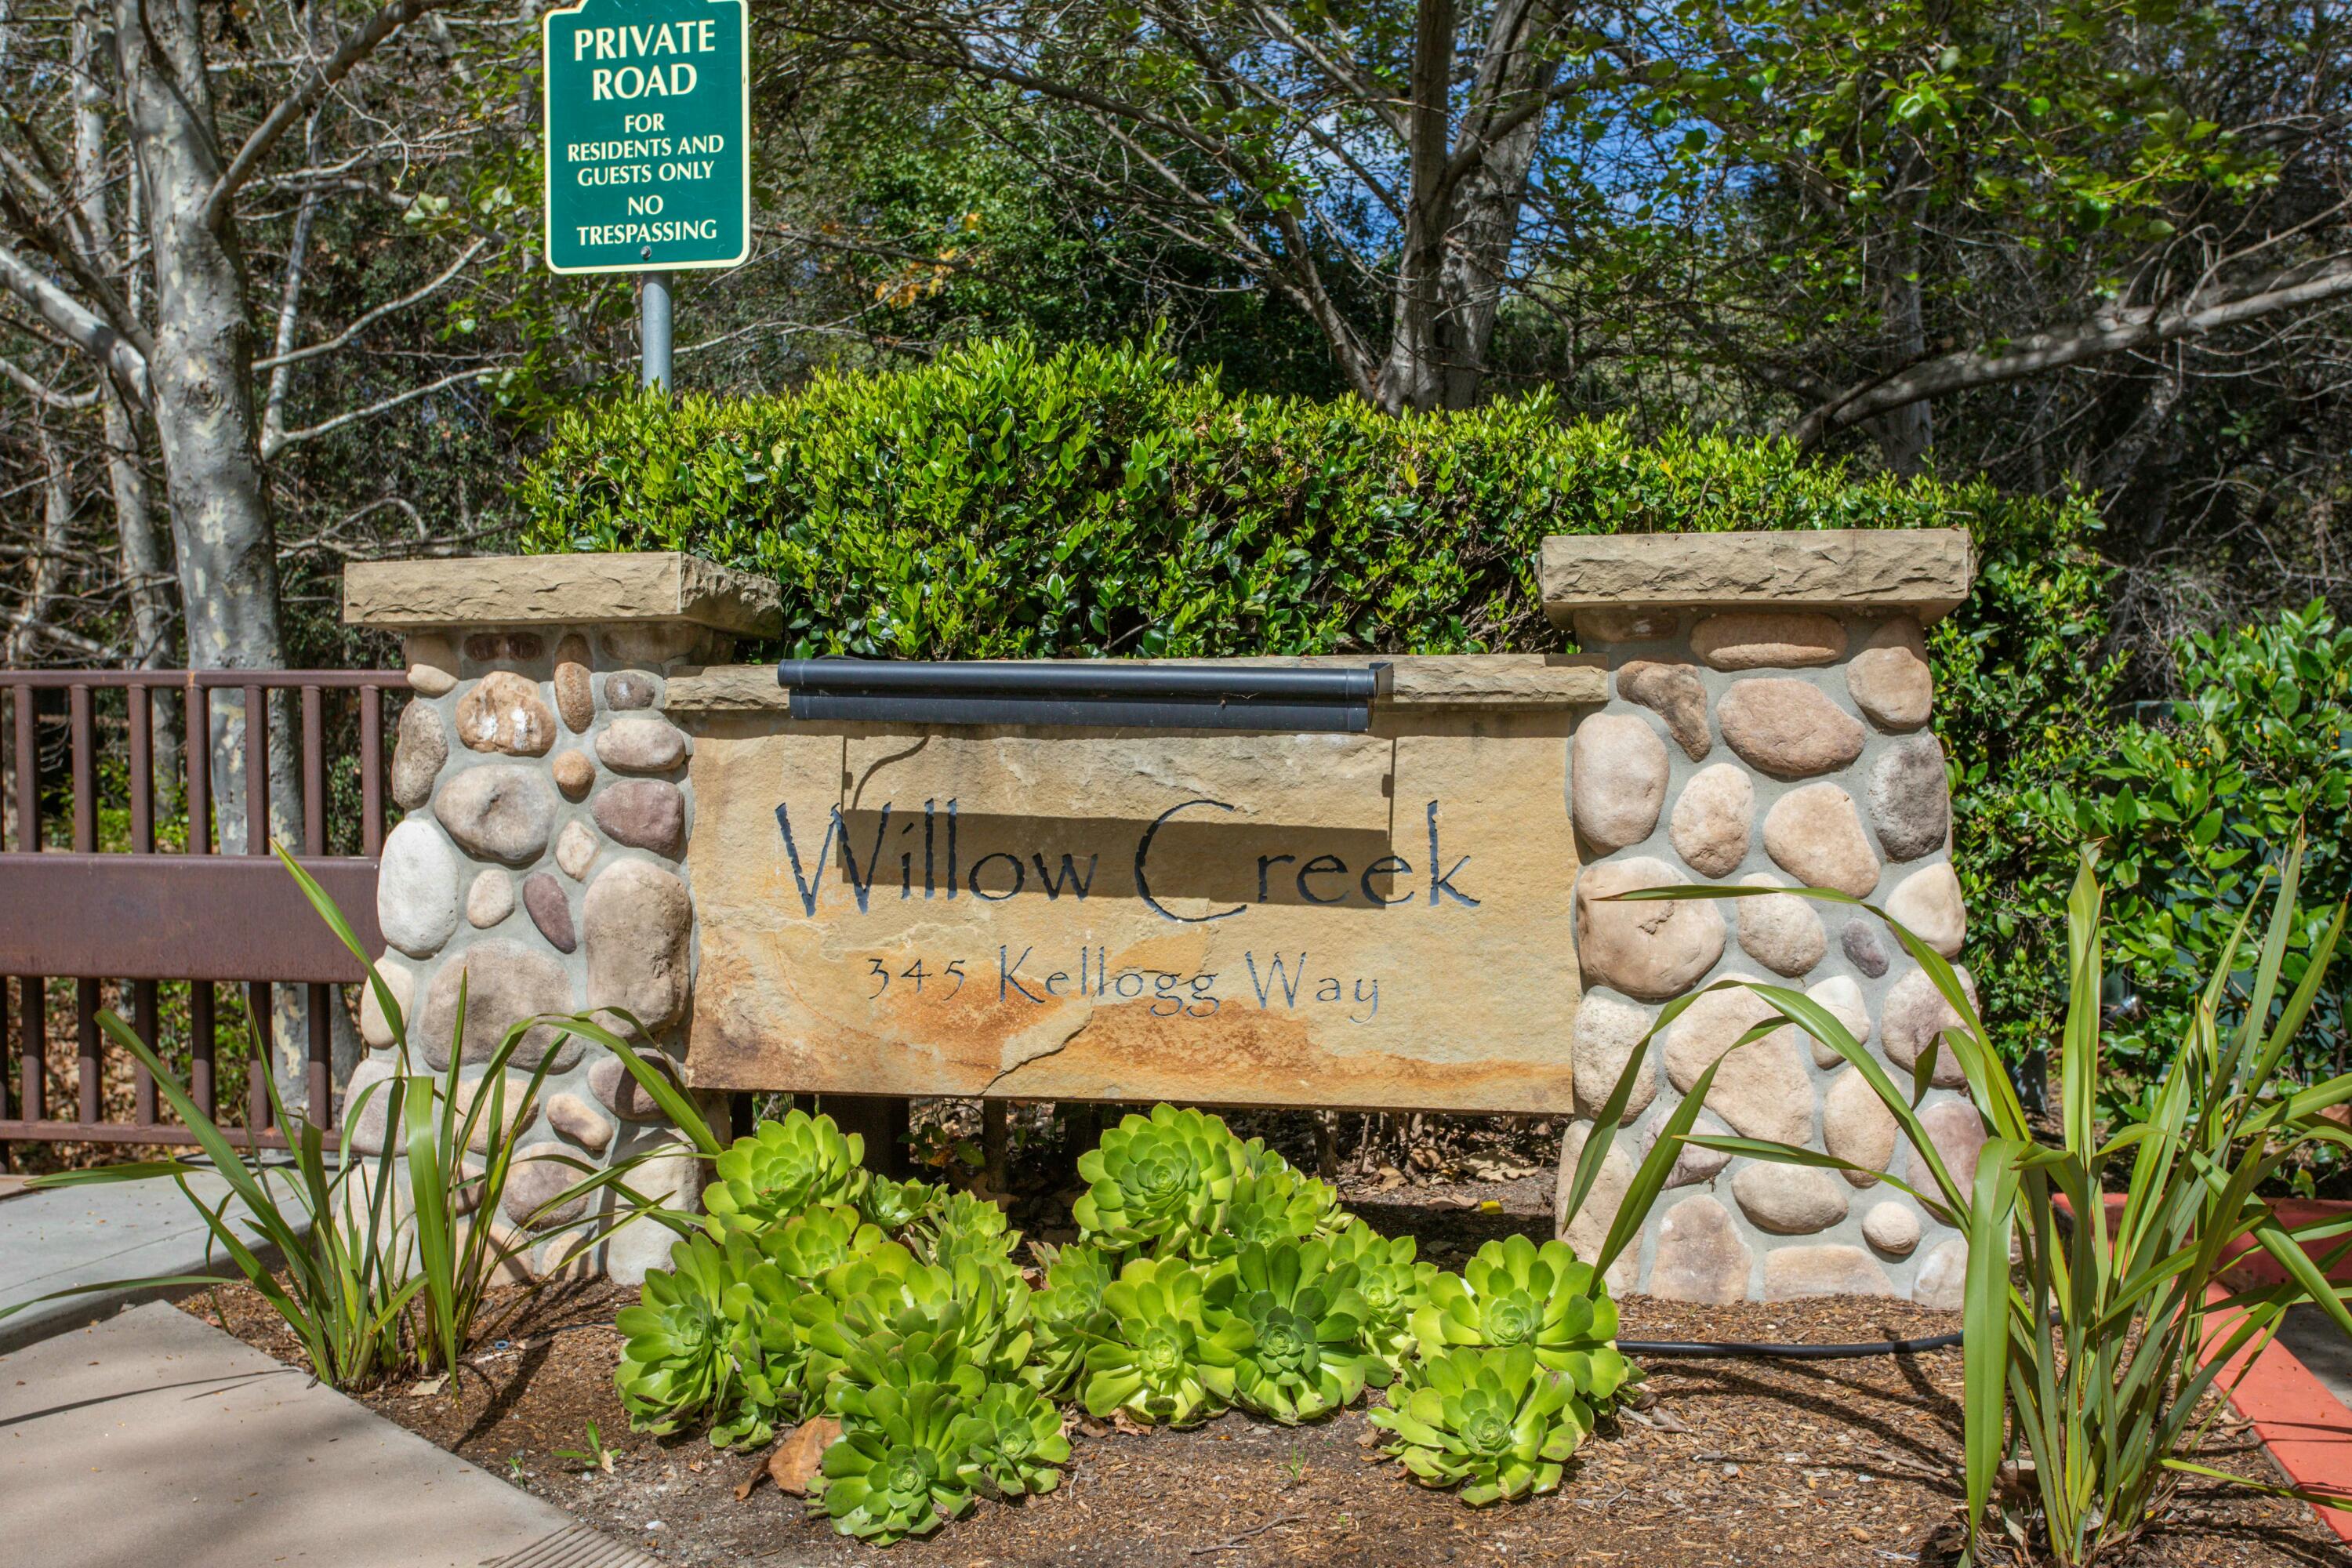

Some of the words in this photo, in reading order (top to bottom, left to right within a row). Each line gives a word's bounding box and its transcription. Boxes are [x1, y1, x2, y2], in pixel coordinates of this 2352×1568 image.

[575, 20, 715, 61] PRIVATE
[593, 63, 697, 100] ROAD
[625, 113, 665, 133] FOR
[568, 137, 671, 162] RESIDENTS
[677, 135, 724, 154] AND
[577, 164, 652, 187] GUESTS
[659, 161, 714, 181] ONLY
[628, 194, 664, 216] NO
[577, 220, 717, 245] TRESPASSING
[775, 797, 1098, 918] Willow
[1134, 799, 1481, 923] Creek
[868, 958, 966, 1000] 345
[1000, 945, 1220, 1018] Kellogg
[1244, 951, 1379, 1024] Way
